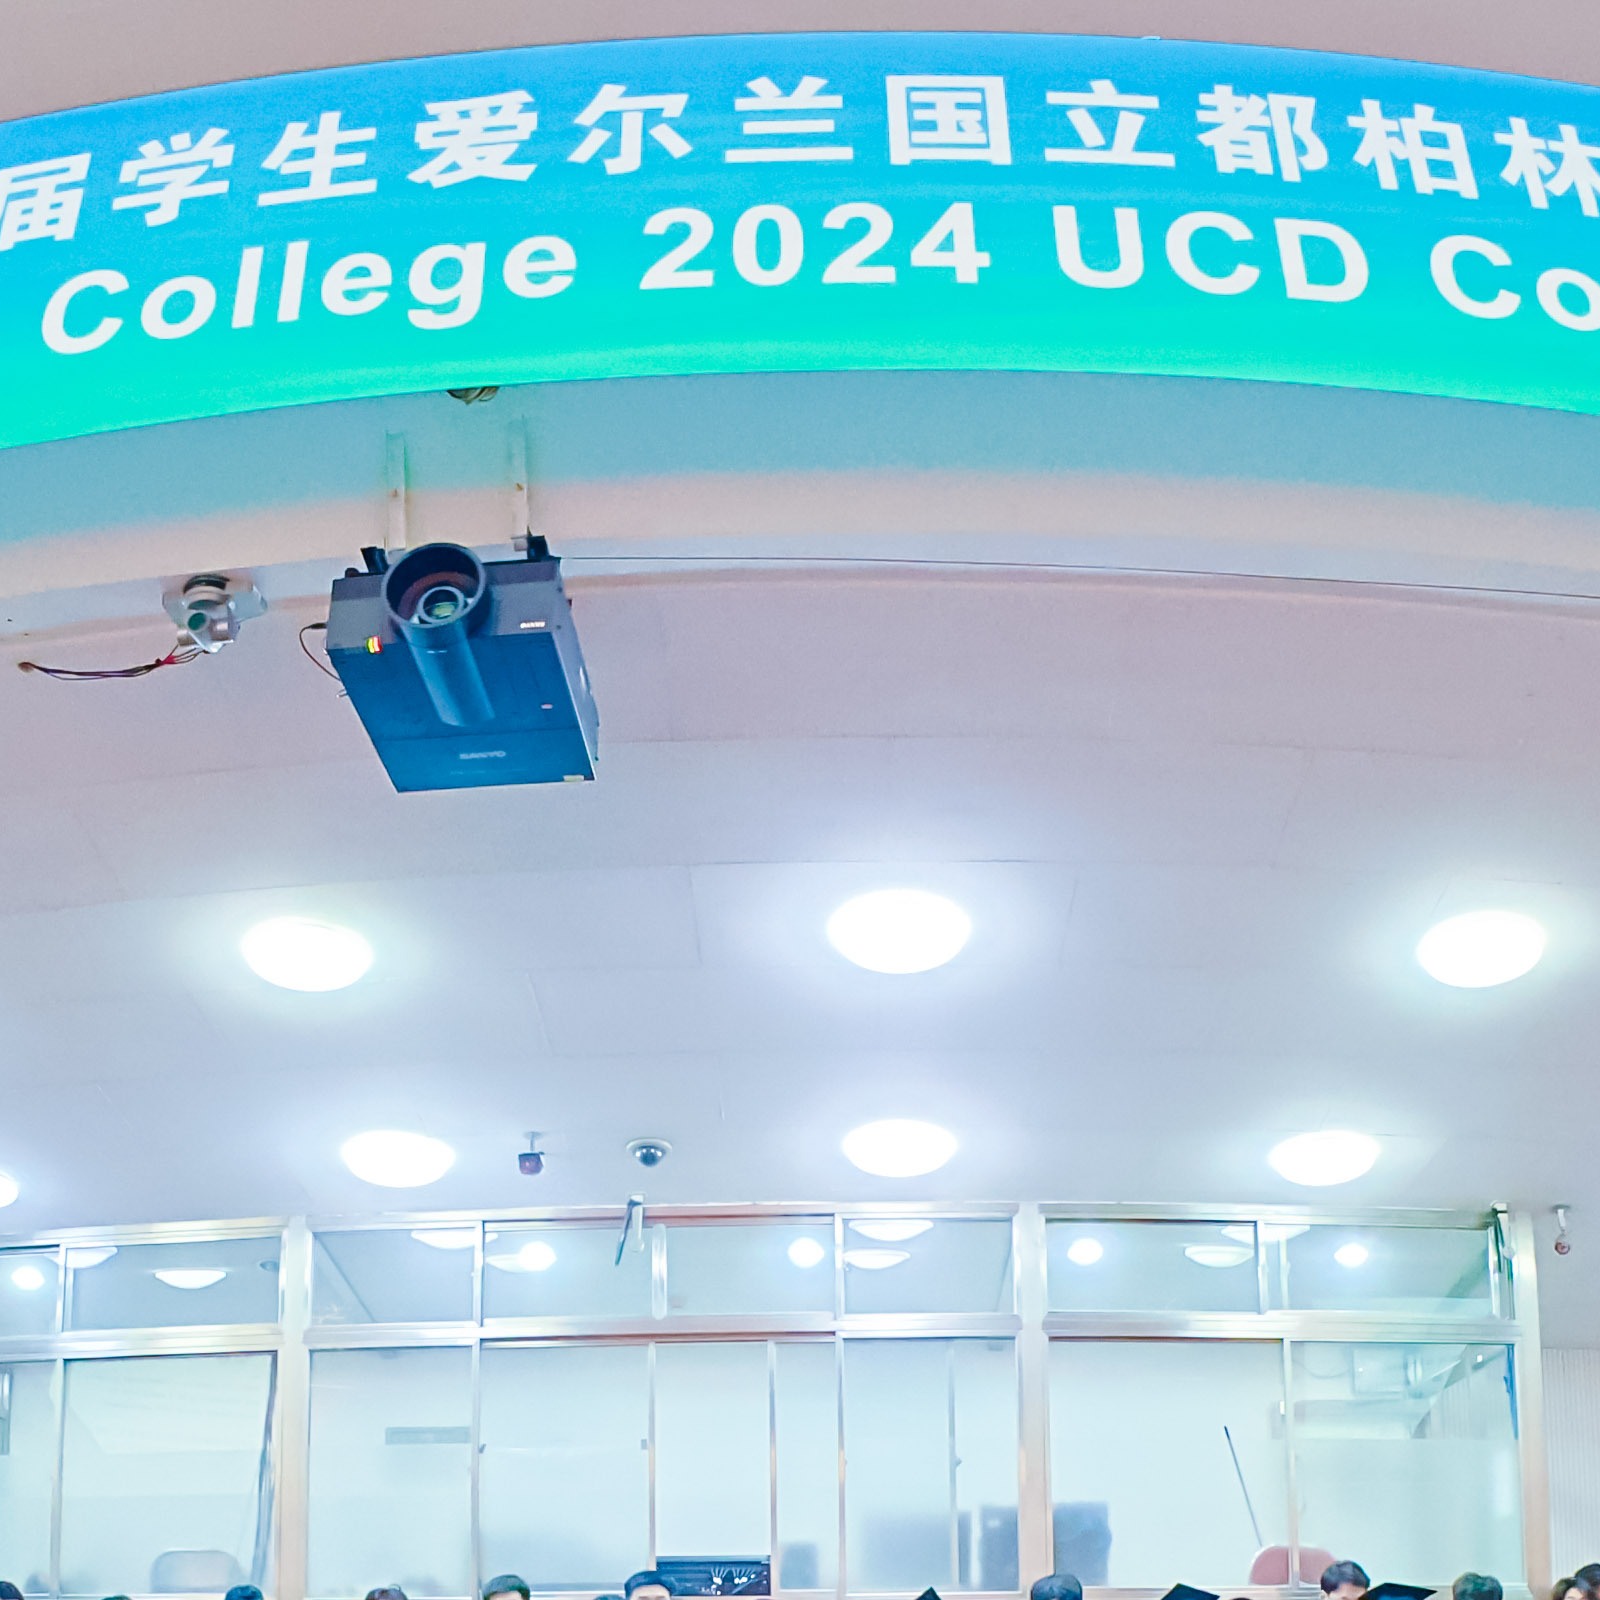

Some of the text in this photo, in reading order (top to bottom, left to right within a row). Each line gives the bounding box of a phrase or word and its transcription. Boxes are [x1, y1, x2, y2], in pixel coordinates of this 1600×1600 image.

[40, 235, 577, 354] College
[639, 202, 991, 290] 2024
[1053, 205, 1369, 302] UCD
